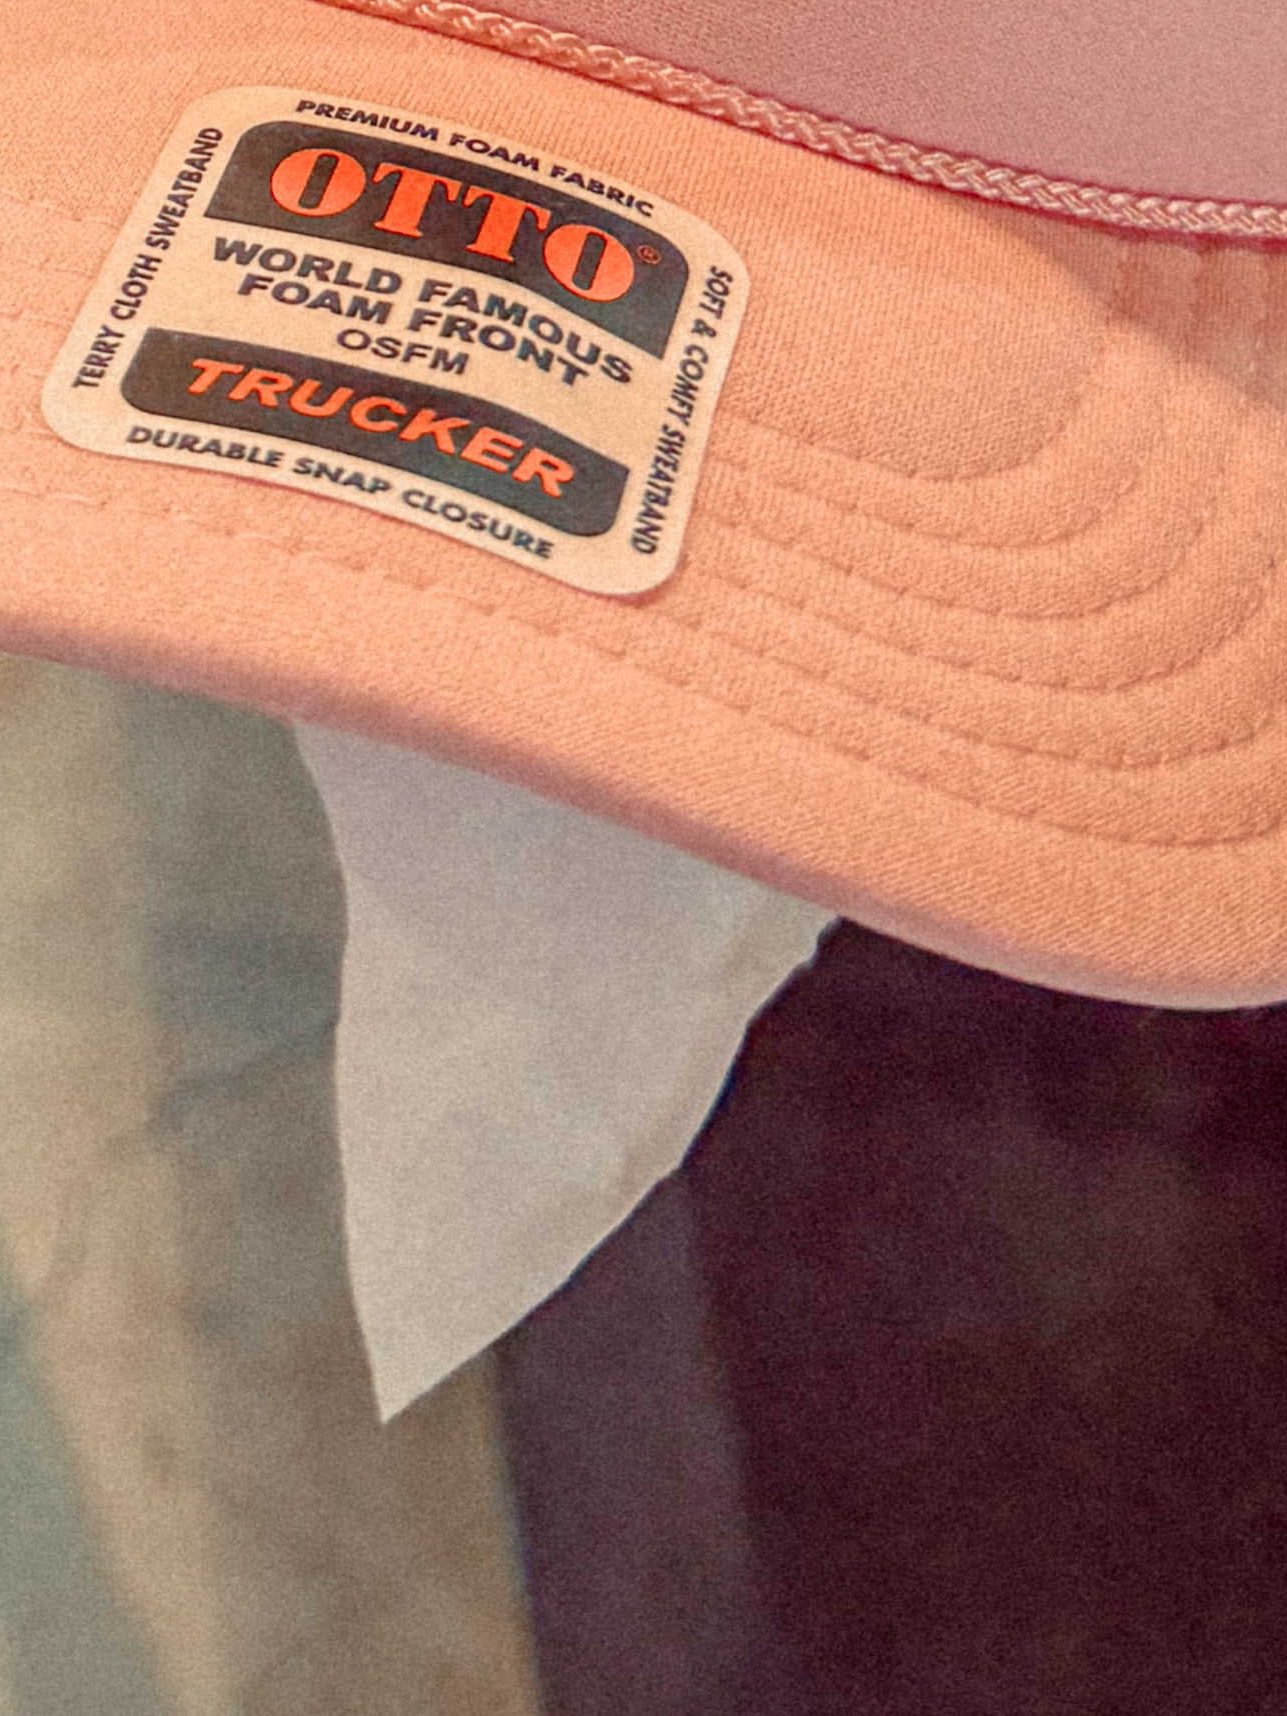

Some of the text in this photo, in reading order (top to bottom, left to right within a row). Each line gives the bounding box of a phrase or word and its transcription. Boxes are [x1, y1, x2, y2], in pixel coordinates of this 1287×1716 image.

[270, 148, 635, 303] OTTO
[296, 99, 655, 218] PREMIUM FOAM FABRIC
[72, 126, 224, 390] TERRY CLOTH SWEATBAND
[213, 236, 634, 384] WORLD FAMOUS
[237, 273, 590, 387] FOAM FRONT
[336, 328, 471, 376] OSFM
[188, 358, 576, 499] TRUCKER
[630, 265, 735, 556] SOFT & COMFY SWEATBAND
[126, 425, 555, 561] DURABLE SNAP CLOSURE
